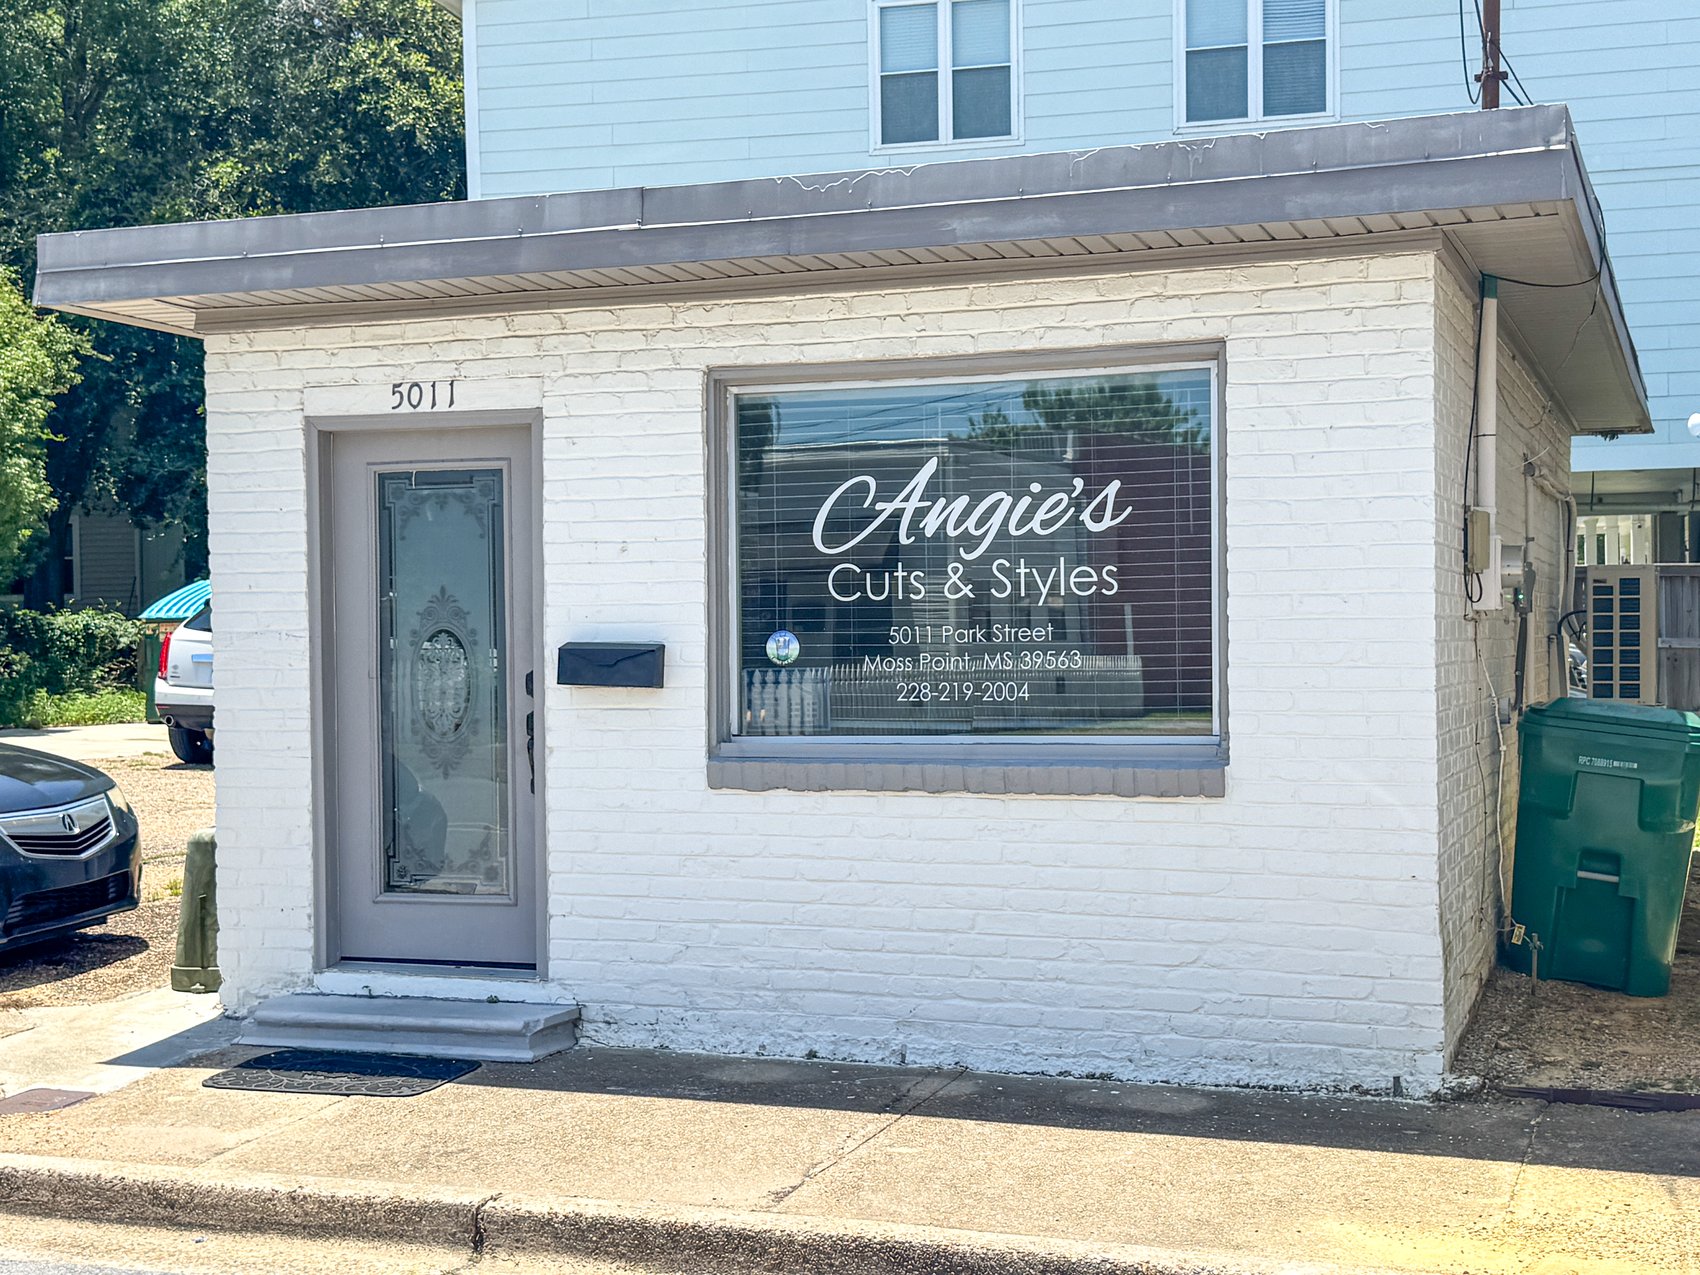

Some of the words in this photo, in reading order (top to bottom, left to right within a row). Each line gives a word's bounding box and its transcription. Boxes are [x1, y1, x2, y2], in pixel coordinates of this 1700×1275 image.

[391, 380, 455, 410] 5011
[811, 456, 1133, 561] Angie's
[827, 561, 926, 602] Cuts
[943, 562, 976, 599] &
[990, 556, 1119, 607] Styles
[888, 625, 932, 645] 5011
[941, 624, 987, 644] Park
[992, 622, 1054, 642] Street
[863, 654, 913, 672] Moss
[919, 653, 975, 672] Point,
[982, 651, 1013, 670] MS
[1019, 650, 1082, 670] 39563
[896, 681, 1030, 702] 228-219-2004
